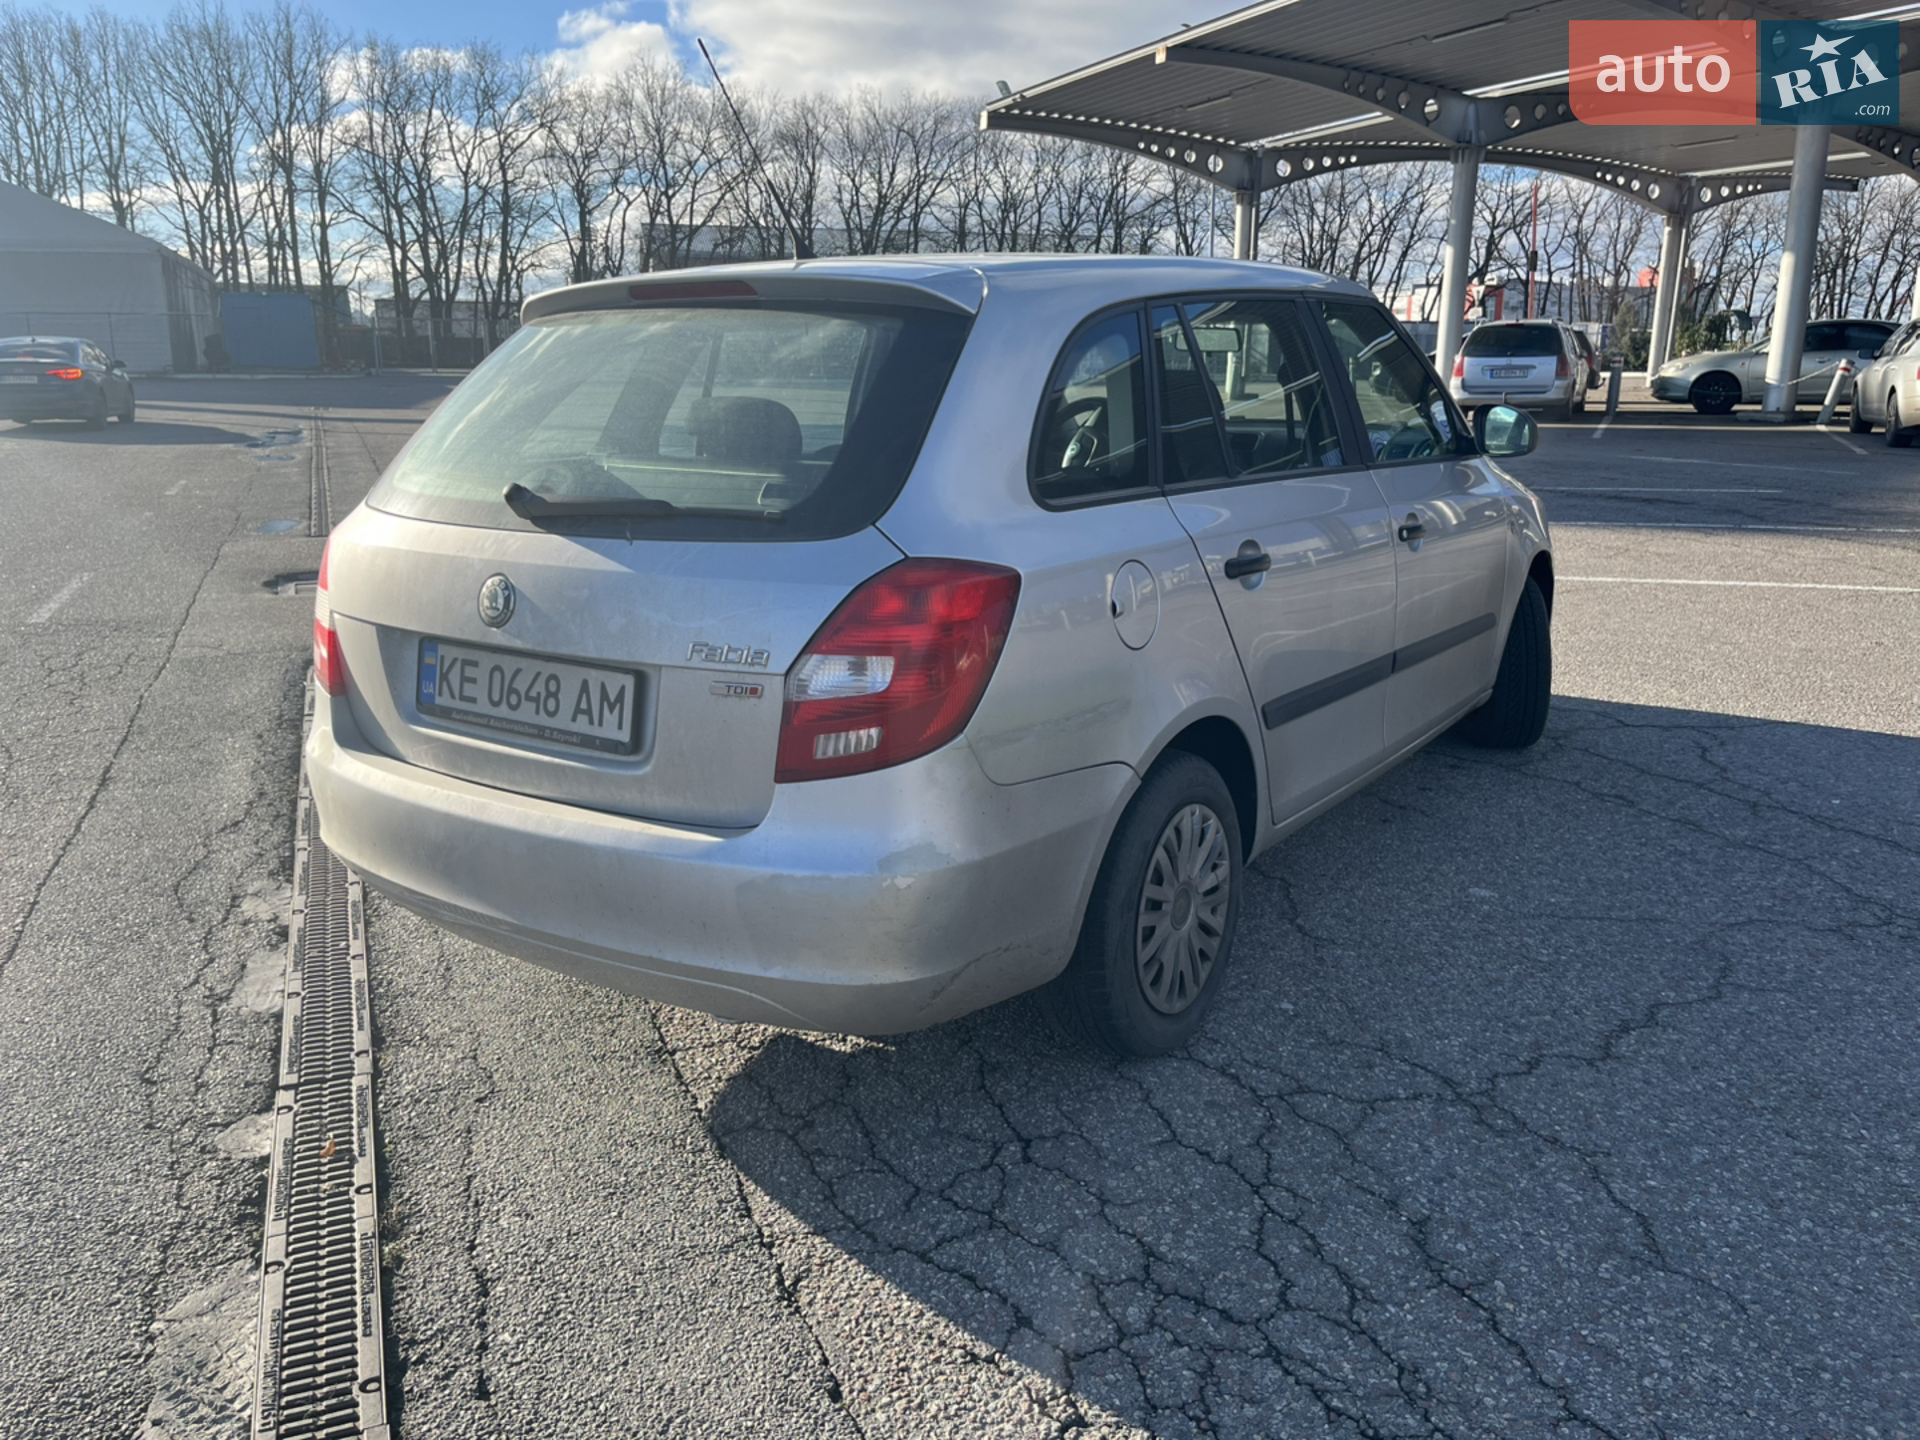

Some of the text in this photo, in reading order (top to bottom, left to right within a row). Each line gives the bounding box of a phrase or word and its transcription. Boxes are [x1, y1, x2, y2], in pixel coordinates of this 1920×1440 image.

[686, 641, 770, 667] Fabia
[422, 680, 434, 694] UA
[438, 655, 626, 731] KE 0648 AM
[725, 684, 748, 696] TDI
